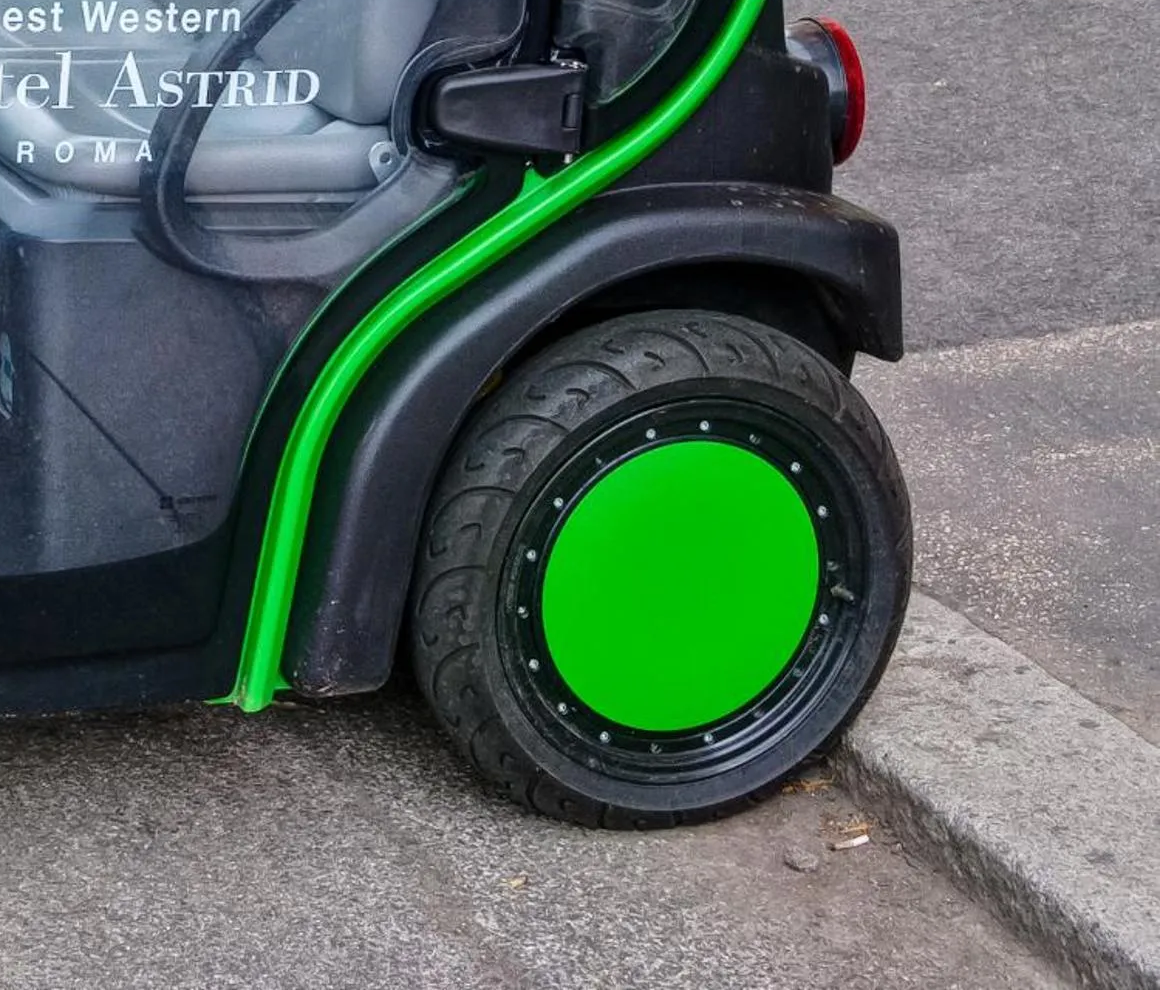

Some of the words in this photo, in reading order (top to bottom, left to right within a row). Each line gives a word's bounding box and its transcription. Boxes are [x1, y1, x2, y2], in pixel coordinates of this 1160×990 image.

[81, 0, 241, 34] Western
[98, 50, 321, 109] ASTRID
[16, 139, 154, 164] ROMA
